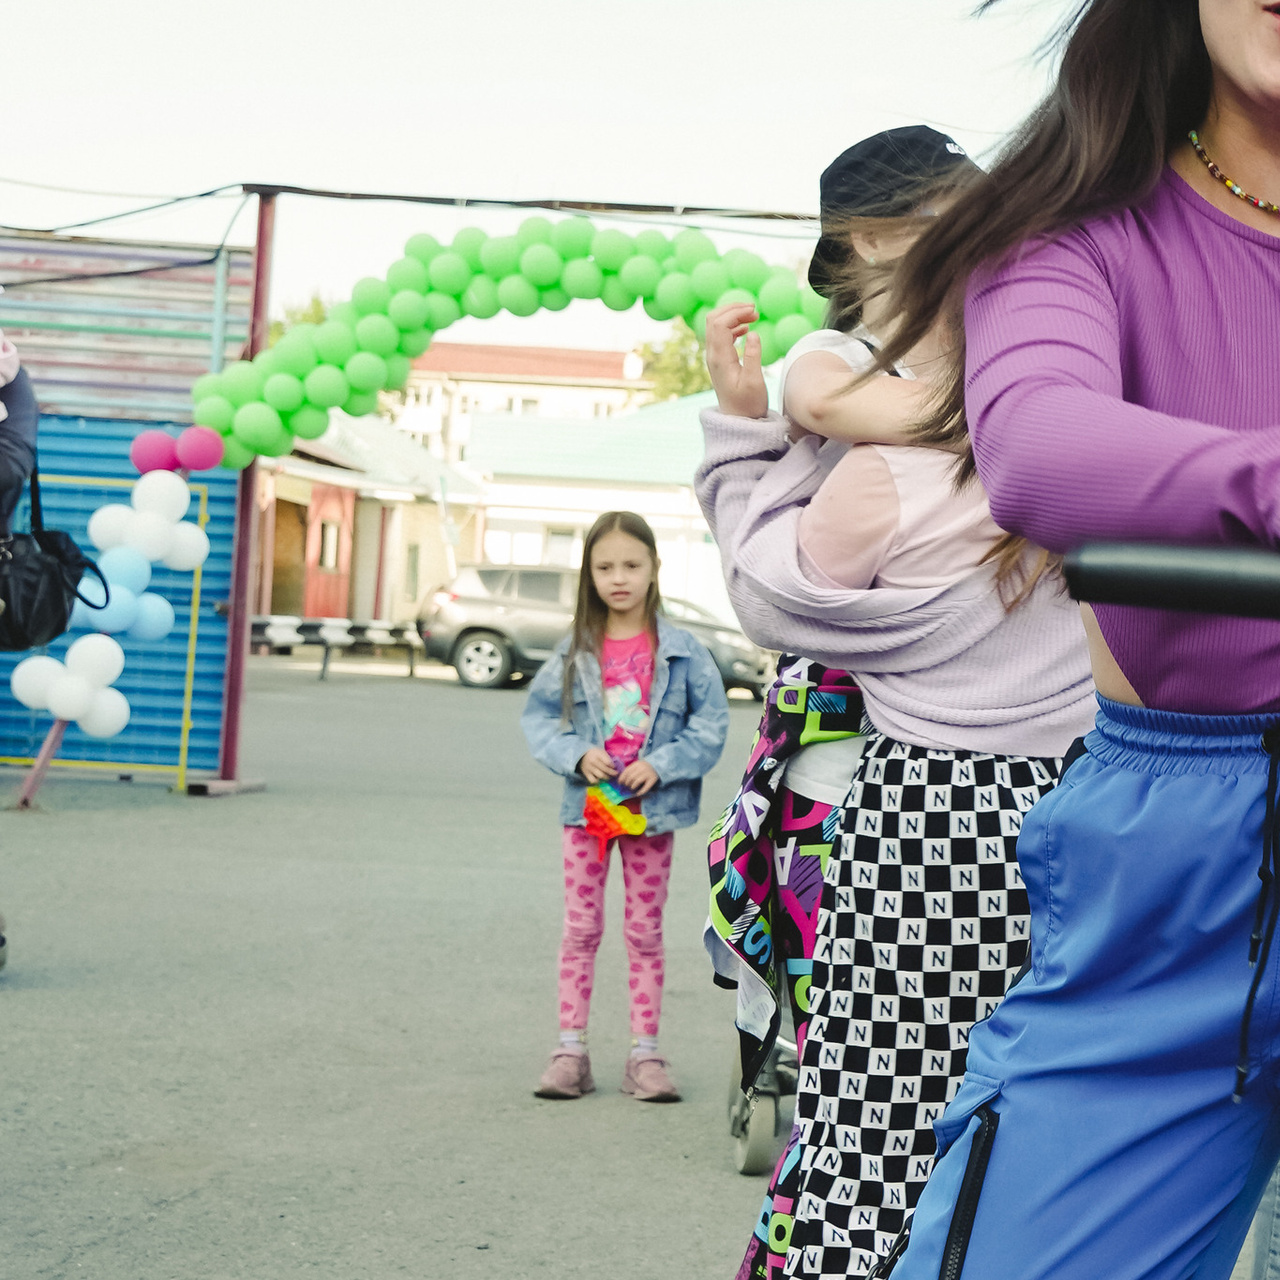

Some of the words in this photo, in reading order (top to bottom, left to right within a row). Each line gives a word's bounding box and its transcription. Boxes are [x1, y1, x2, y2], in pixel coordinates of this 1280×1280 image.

[909, 765, 921, 780] N
[959, 766, 969, 782] N
[888, 791, 897, 806] N
[934, 792, 946, 806] N
[980, 792, 992, 807] N
[1021, 792, 1034, 806] N
[864, 816, 877, 832] N
[906, 818, 918, 833] N
[958, 817, 970, 832] N
[1009, 816, 1020, 830] N
[932, 845, 944, 860] N
[986, 843, 998, 858] N
[859, 868, 872, 883] N
[908, 872, 918, 886] N
[960, 870, 972, 886] N
[836, 892, 850, 907] N
[883, 897, 896, 912] N
[933, 898, 945, 913] N
[988, 896, 1000, 912] N
[907, 924, 920, 940] N
[961, 924, 973, 939] N
[1014, 920, 1026, 935] N
[879, 949, 890, 965] N
[932, 951, 945, 966] N
[988, 950, 1000, 965] N
[858, 972, 870, 988] N
[905, 977, 917, 992] N
[959, 977, 972, 992] N
[834, 997, 848, 1012] N
[880, 1001, 892, 1016] N
[932, 1003, 943, 1019] N
[855, 1026, 866, 1041] N
[905, 1028, 919, 1044] N
[957, 1028, 969, 1043] N
[825, 1048, 838, 1064] N
[877, 1054, 890, 1070] N
[931, 1056, 944, 1071] N
[806, 1072, 817, 1088] N
[846, 1078, 860, 1094] N
[901, 1082, 914, 1098] N
[870, 1108, 884, 1124] N
[924, 1108, 938, 1124] N
[844, 1131, 856, 1147] N
[892, 1136, 908, 1151] N
[823, 1153, 838, 1169] N
[870, 1160, 878, 1176] N
[838, 1184, 853, 1200] N
[890, 1189, 900, 1204] N
[807, 1199, 819, 1214] N
[858, 1211, 872, 1224] N
[832, 1230, 844, 1242] N
[883, 1239, 893, 1252] N
[857, 1254, 872, 1270] N
